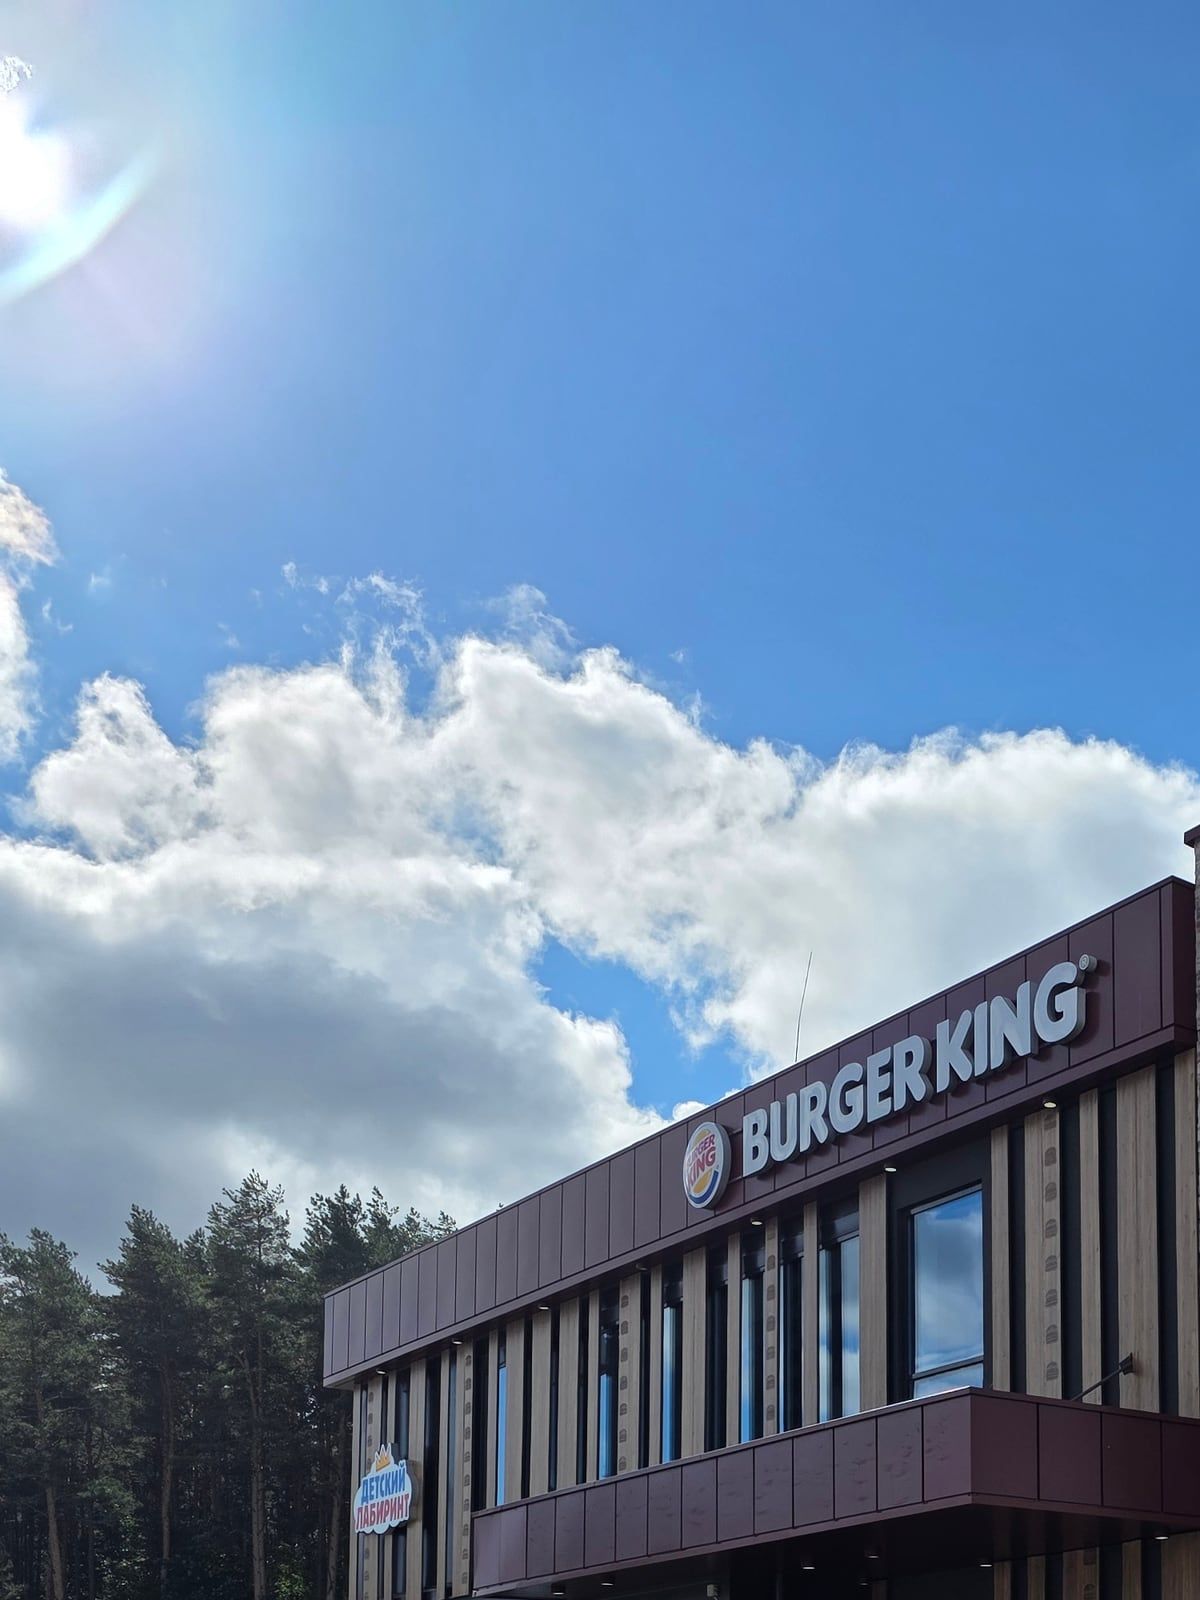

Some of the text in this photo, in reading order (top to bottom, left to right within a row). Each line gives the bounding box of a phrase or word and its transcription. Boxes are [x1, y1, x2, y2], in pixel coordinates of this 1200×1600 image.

[742, 961, 1086, 1178] BURGER KING
[361, 1462, 406, 1505] ДЕТСКИЙ
[356, 1493, 409, 1530] ЛАБИРИНТ
